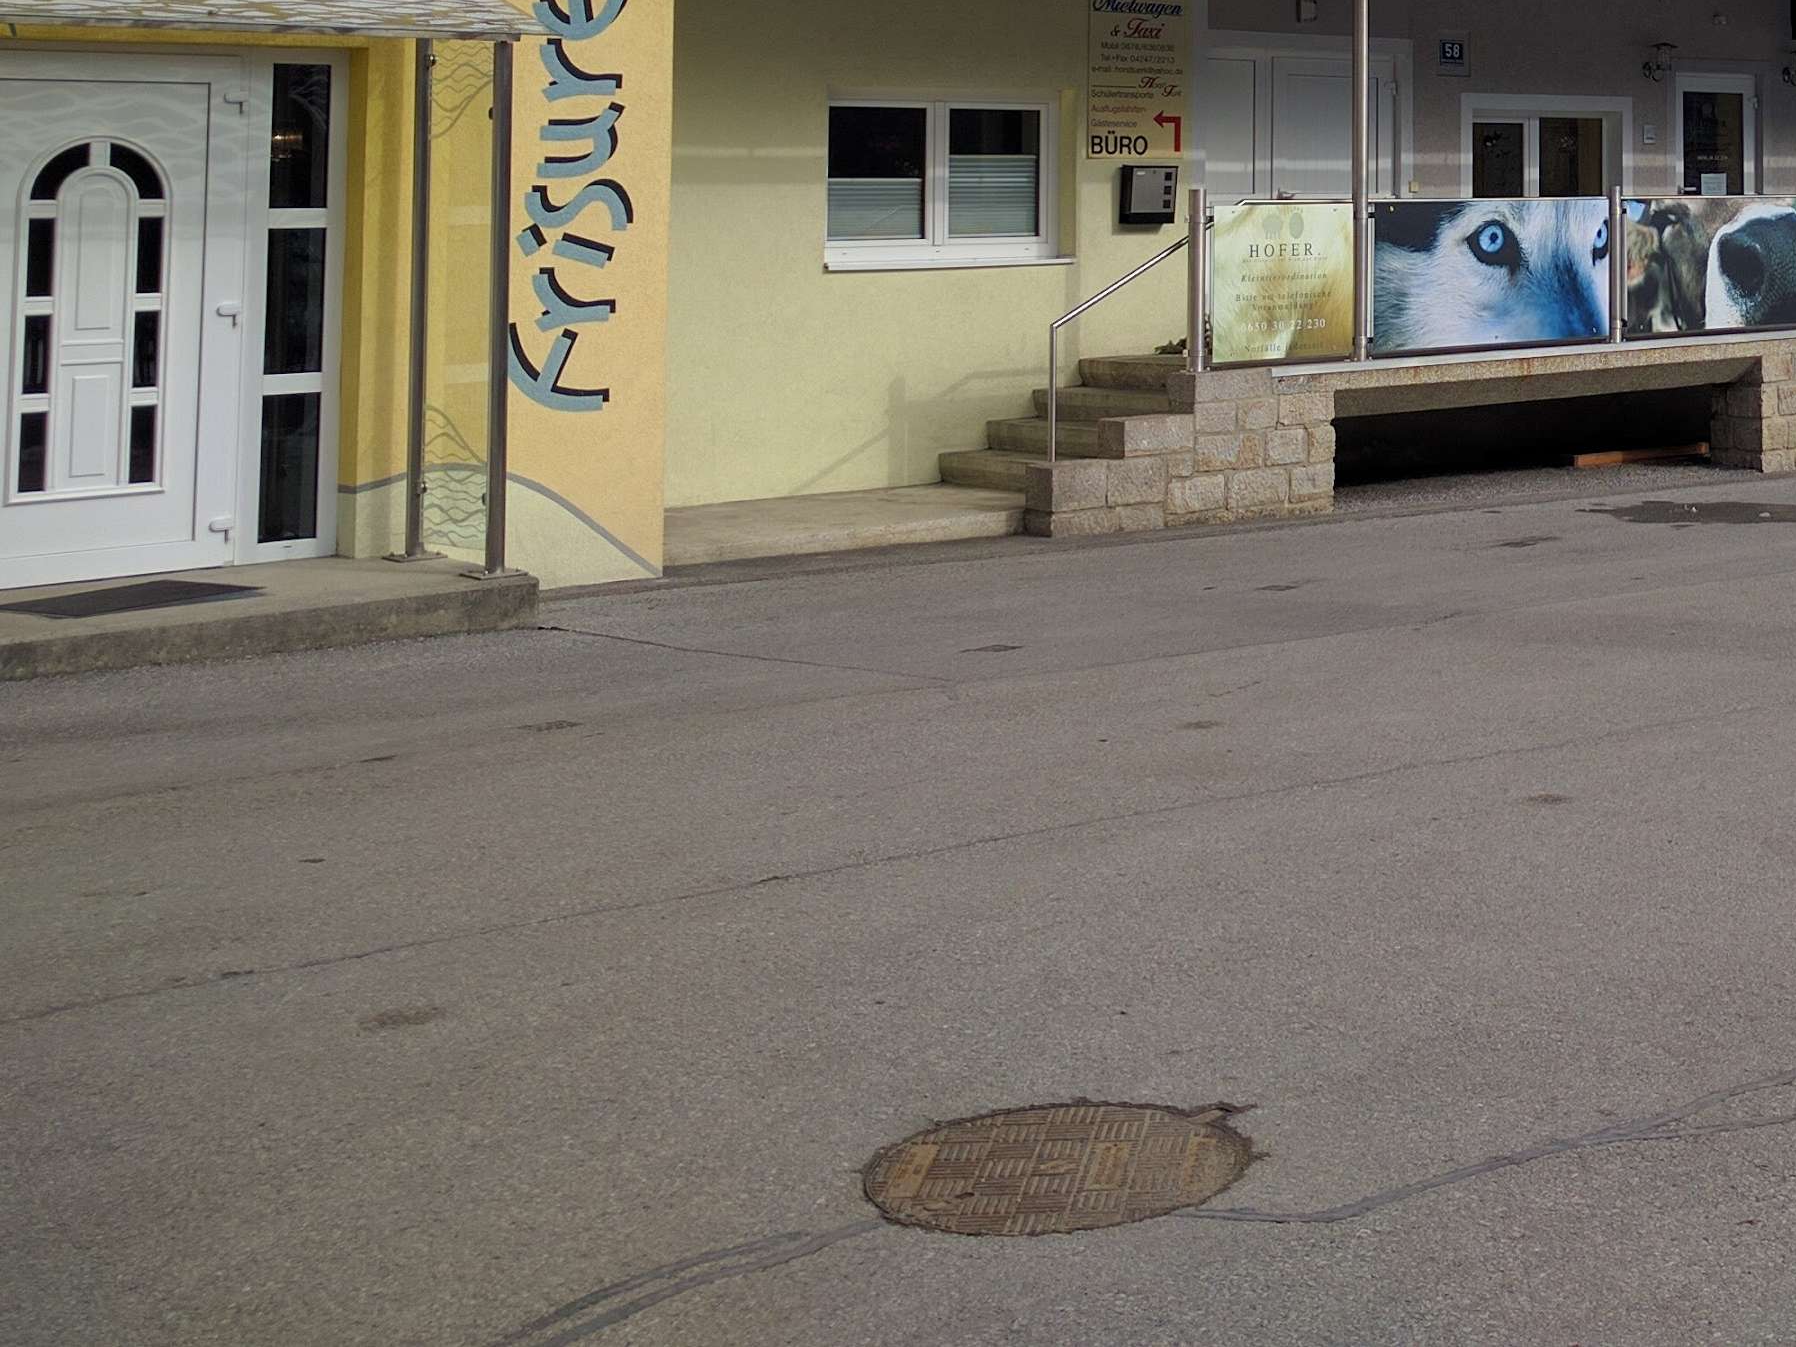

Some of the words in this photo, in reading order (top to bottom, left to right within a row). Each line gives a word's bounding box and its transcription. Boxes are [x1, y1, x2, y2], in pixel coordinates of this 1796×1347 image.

[1123, 17, 1166, 39] Taxi
[1445, 43, 1460, 58] 58
[1091, 130, 1148, 156] BÜRO
[1306, 317, 1327, 330] 230
